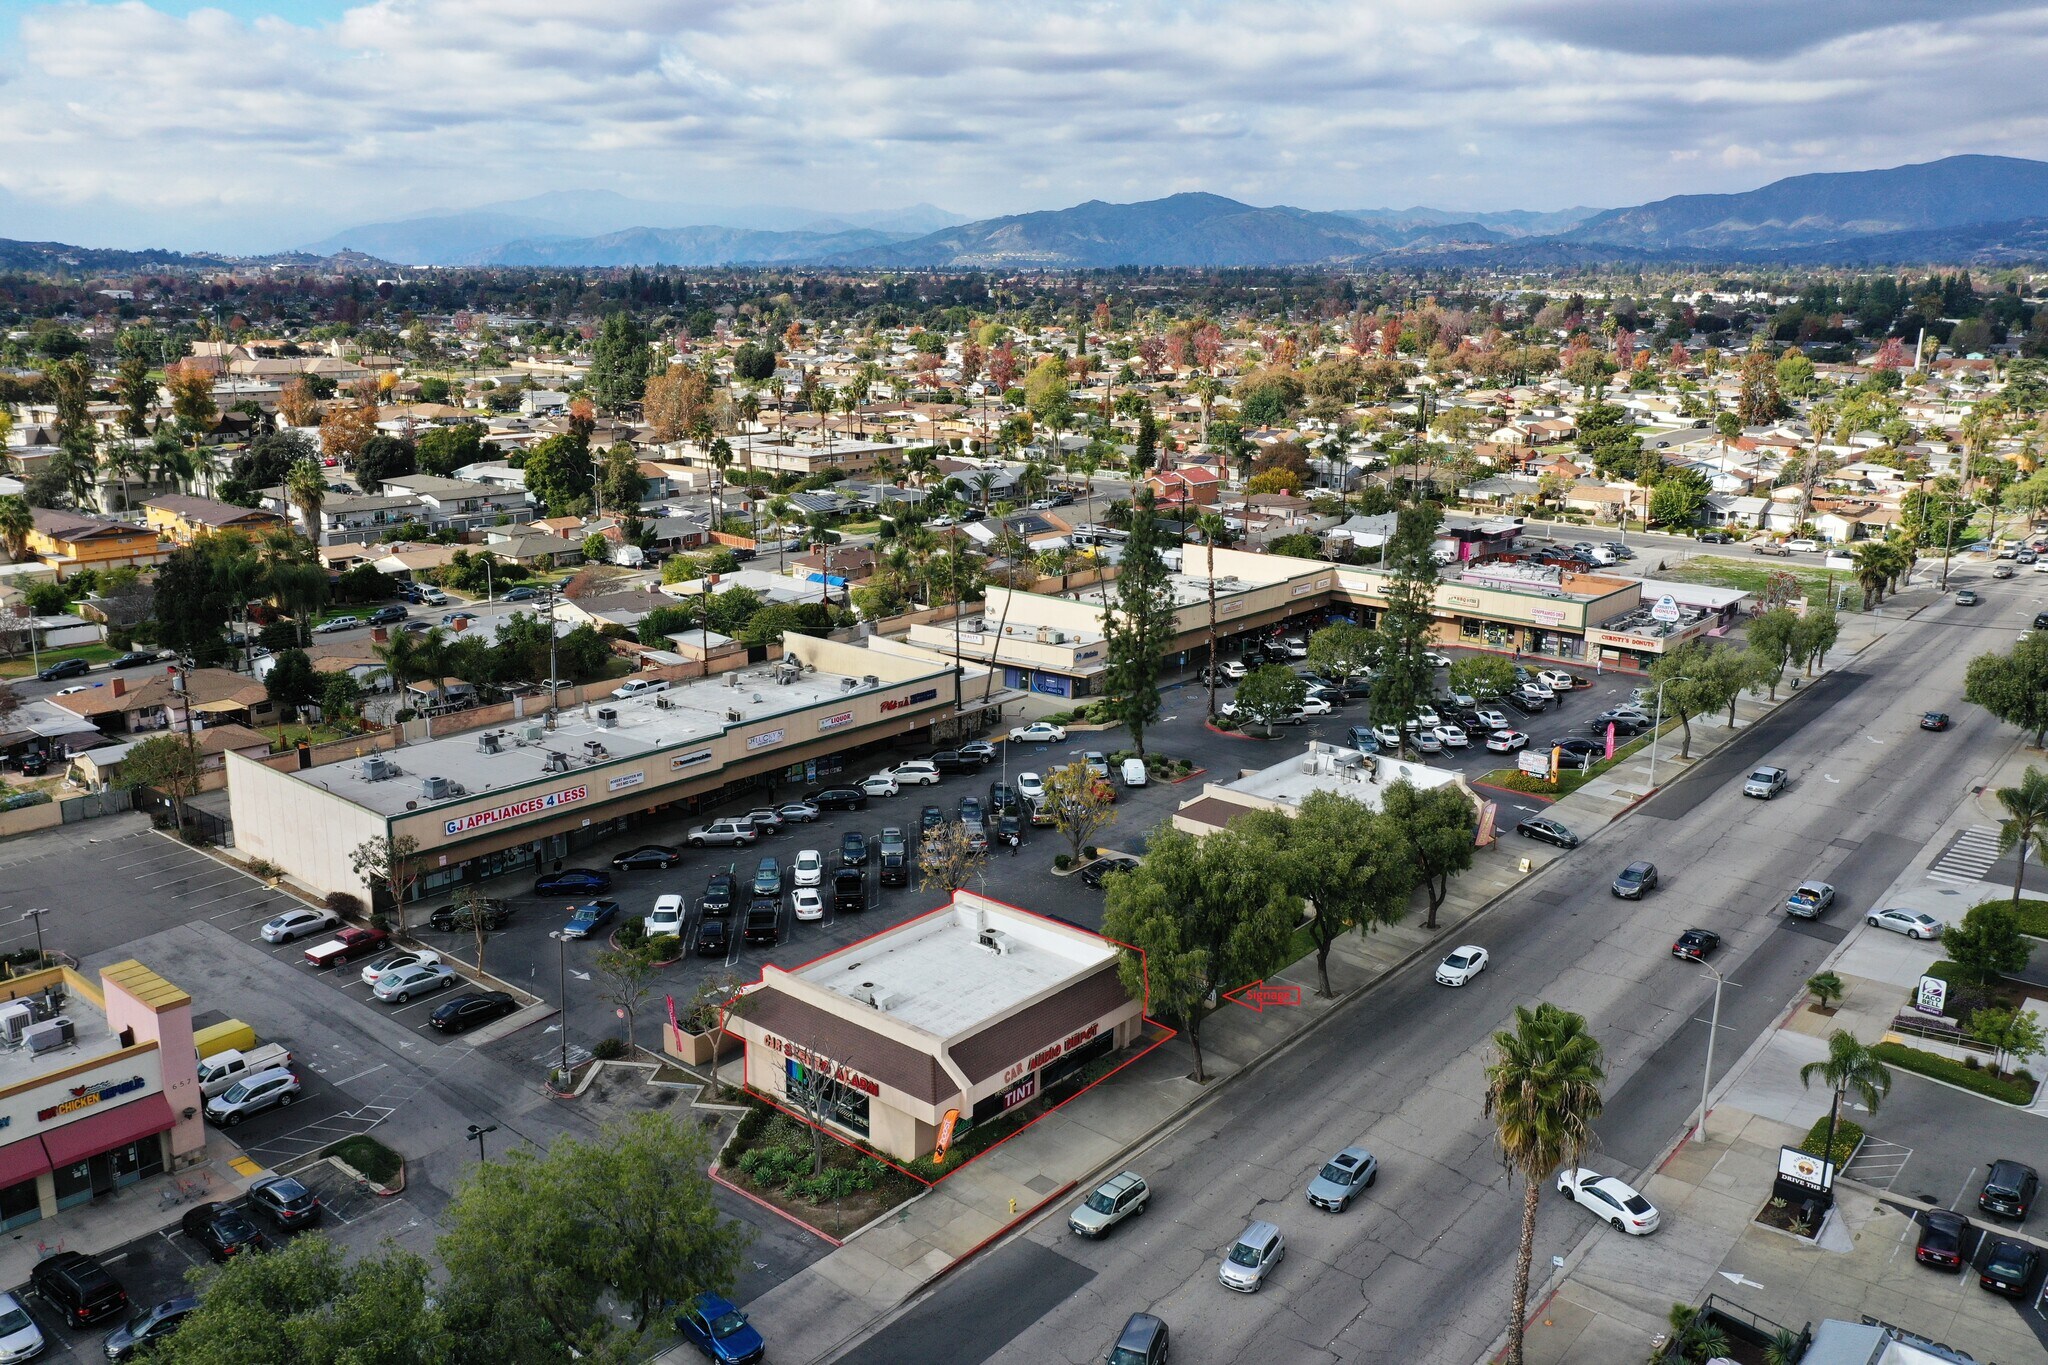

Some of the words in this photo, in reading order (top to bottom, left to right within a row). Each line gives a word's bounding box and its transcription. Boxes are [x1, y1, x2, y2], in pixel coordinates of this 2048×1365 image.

[1601, 634, 1629, 644] CHRISTY'S
[1632, 639, 1655, 647] DONUTS
[831, 713, 851, 724] LIQUOR
[447, 820, 463, 834] GJ
[467, 798, 543, 829] APPLIANCES
[546, 795, 555, 806] 4
[557, 787, 586, 804] LESS
[1922, 993, 1942, 1002] TACO
[1922, 999, 1939, 1007] BELL
[1003, 1062, 1023, 1084] CAR
[1028, 1044, 1062, 1071] AUDIO
[1065, 1023, 1099, 1051] DEPOT
[764, 1034, 782, 1051] CAR
[836, 1066, 880, 1097] ALARM
[172, 1078, 192, 1090] 657
[58, 1092, 99, 1115] CHICKEN
[99, 1076, 145, 1101] REPUBLIC
[1005, 1081, 1033, 1107] TINT
[939, 1119, 951, 1145] boost
[1781, 1174, 1805, 1186] DRIVE
